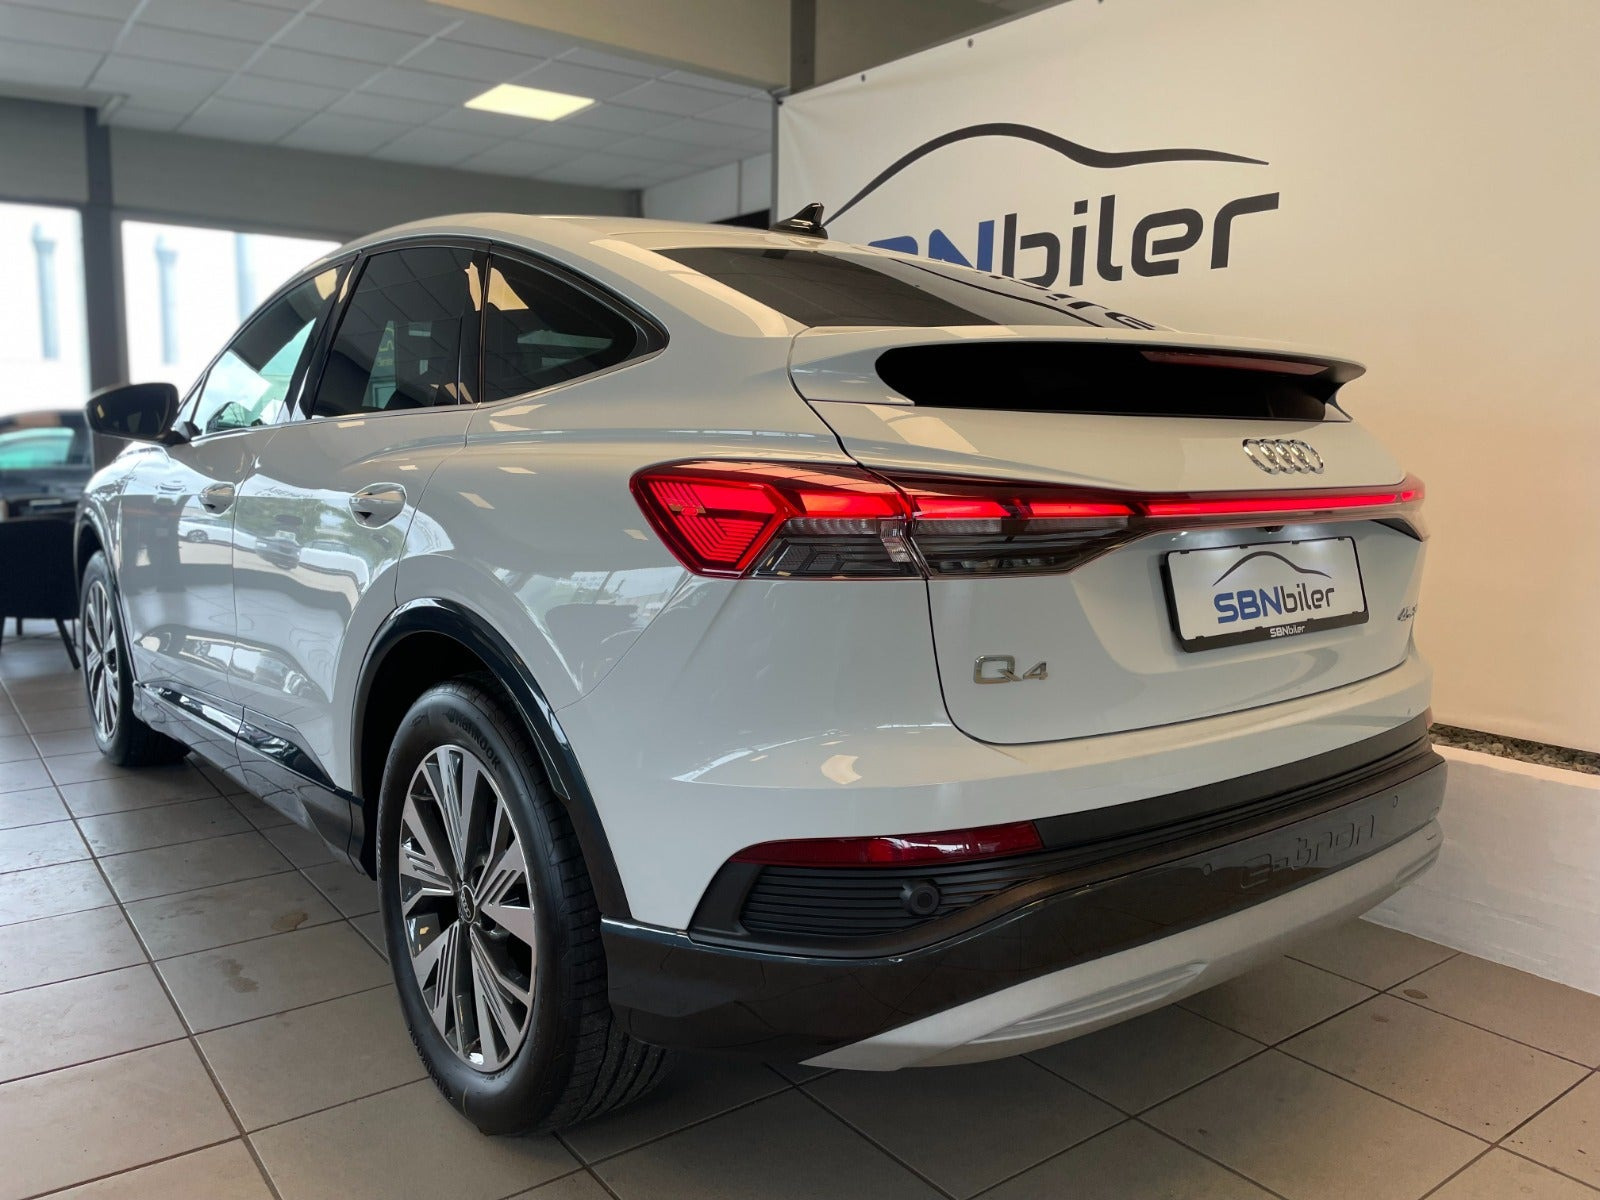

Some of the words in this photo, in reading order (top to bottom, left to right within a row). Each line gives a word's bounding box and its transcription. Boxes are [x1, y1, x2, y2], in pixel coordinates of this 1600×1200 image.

[867, 191, 1280, 289] Nbiler
[1213, 582, 1335, 624] SBNbiler
[1269, 624, 1306, 638] SBNbiler
[973, 654, 1049, 685] Q4
